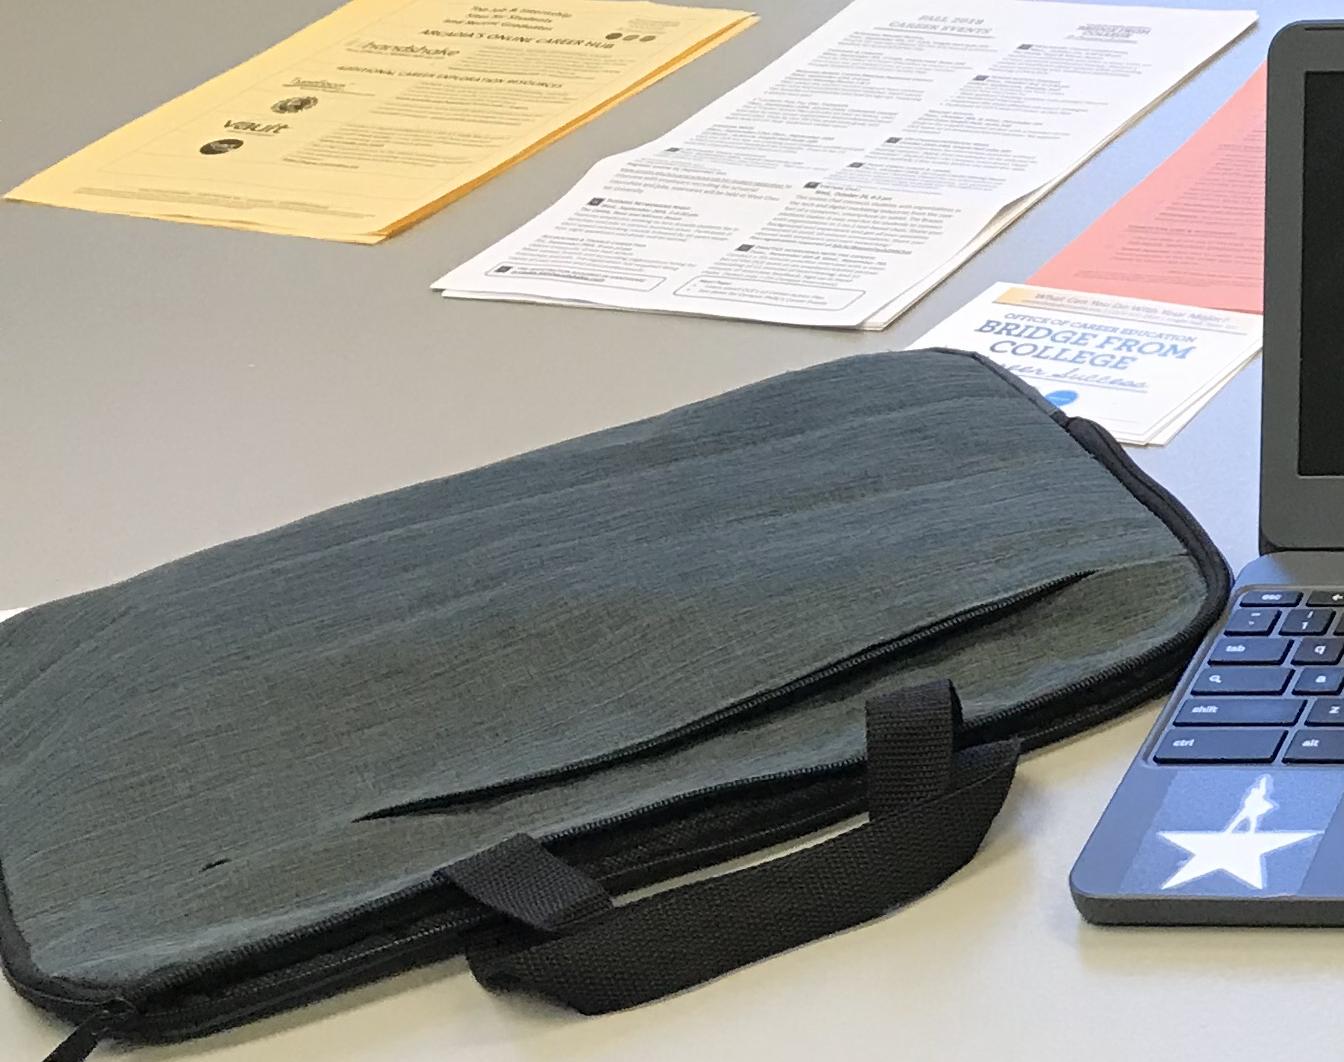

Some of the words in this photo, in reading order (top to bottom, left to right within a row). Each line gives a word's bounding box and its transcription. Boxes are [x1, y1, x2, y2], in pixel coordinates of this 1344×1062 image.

[974, 319, 1098, 346] BRIDGE
[1095, 336, 1197, 360] FROM
[1004, 312, 1048, 323] OFFICE
[1050, 318, 1068, 327] OF
[1069, 320, 1120, 333] CAREER
[1120, 326, 1198, 343] EDUCATION
[988, 340, 1139, 371] COLLEGE
